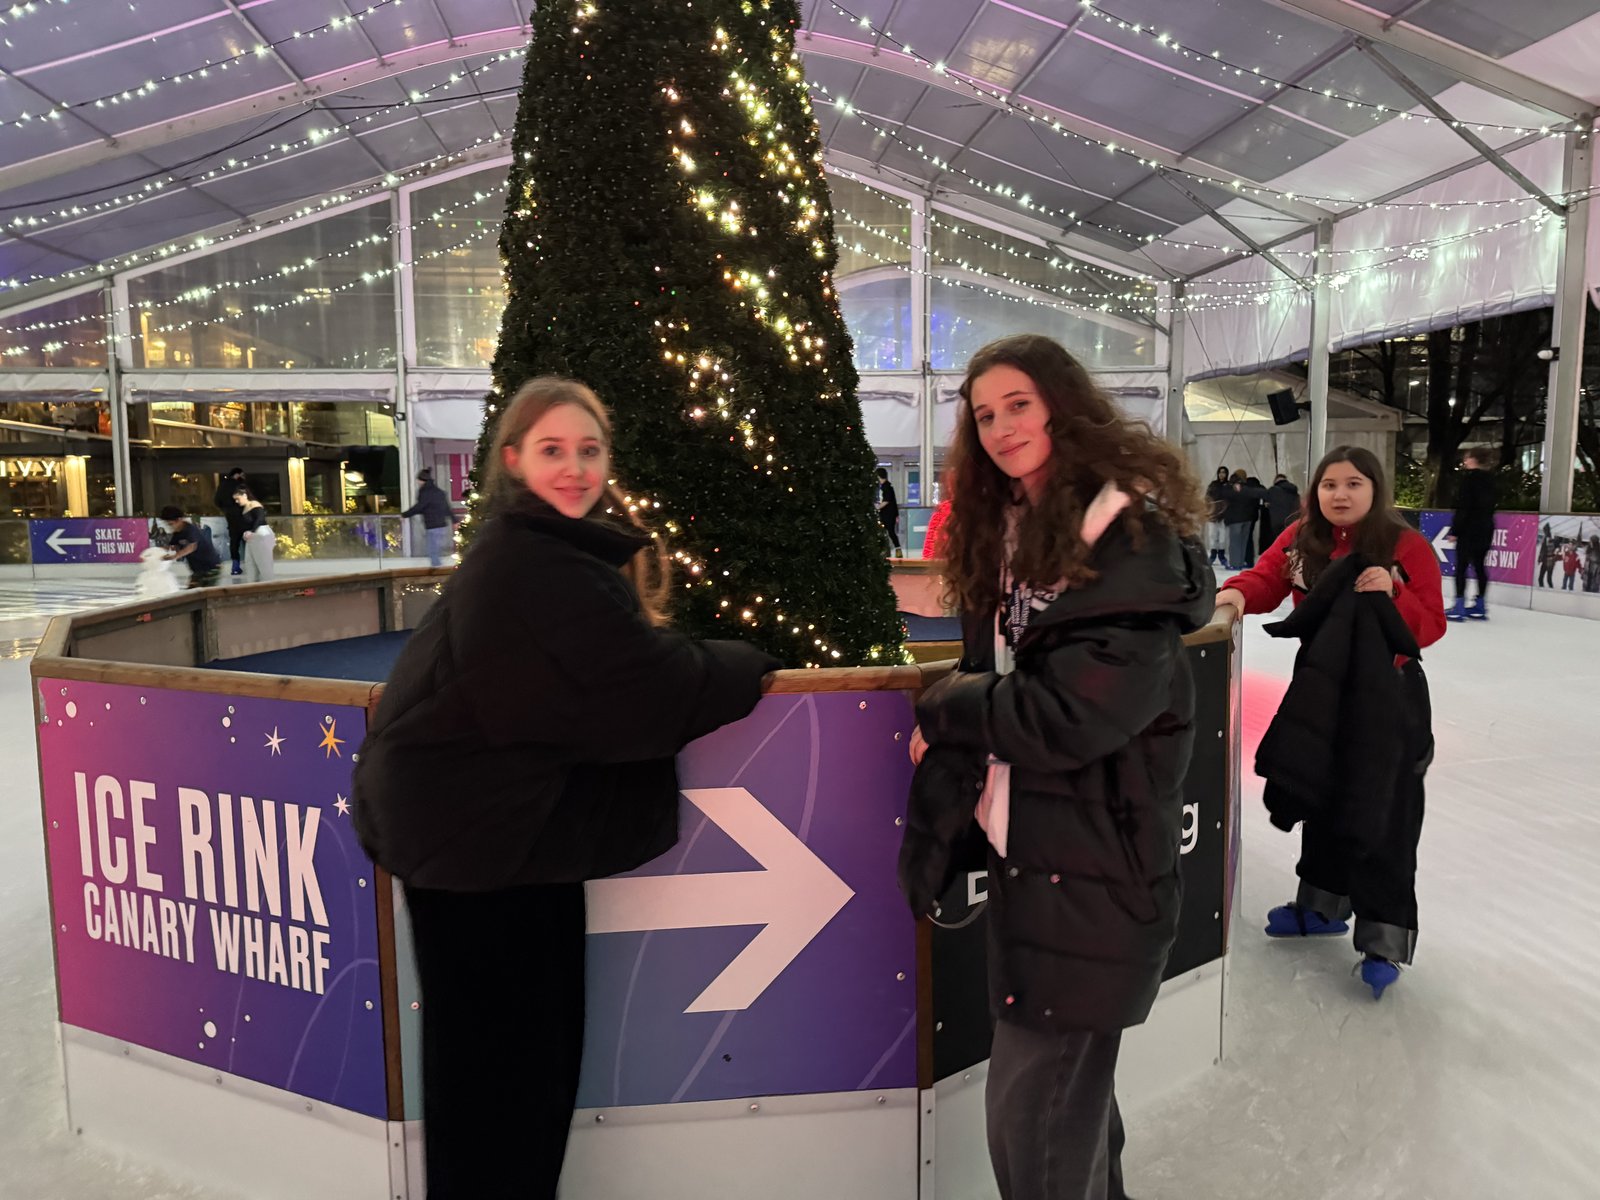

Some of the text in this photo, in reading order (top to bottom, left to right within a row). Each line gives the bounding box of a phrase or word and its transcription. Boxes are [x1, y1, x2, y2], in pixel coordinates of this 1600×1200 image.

[95, 528, 122, 540] SKATE
[1491, 529, 1508, 547] ATE
[96, 542, 135, 554] THIS WAY
[1500, 551, 1519, 569] WAY
[74, 772, 330, 927] ICE RINK
[83, 882, 331, 995] CANARY WHARF
